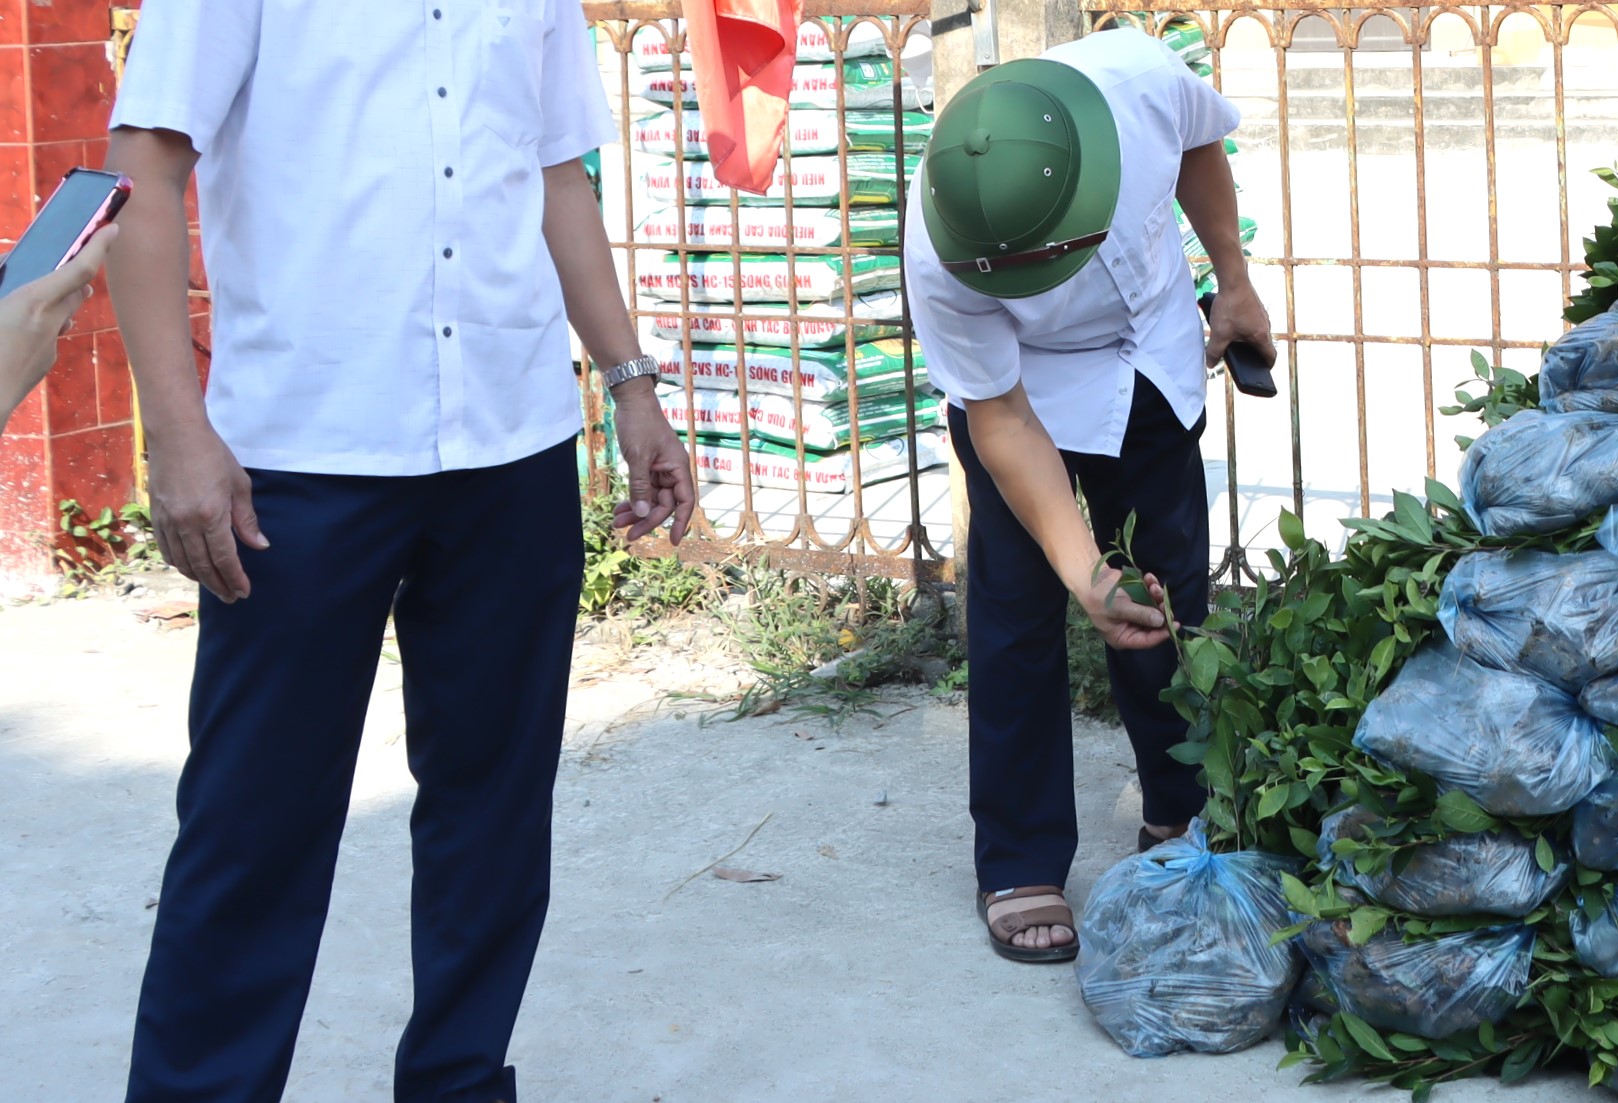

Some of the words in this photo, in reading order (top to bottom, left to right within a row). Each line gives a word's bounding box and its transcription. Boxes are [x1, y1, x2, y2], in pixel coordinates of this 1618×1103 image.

[638, 272, 662, 288] HÂN
[666, 274, 698, 288] HCS
[775, 274, 812, 288] GINH
[659, 360, 680, 375] HÂN
[691, 362, 712, 376] CVS
[715, 362, 738, 378] HC-1
[781, 370, 815, 388] GINH
[750, 462, 768, 476] ANH
